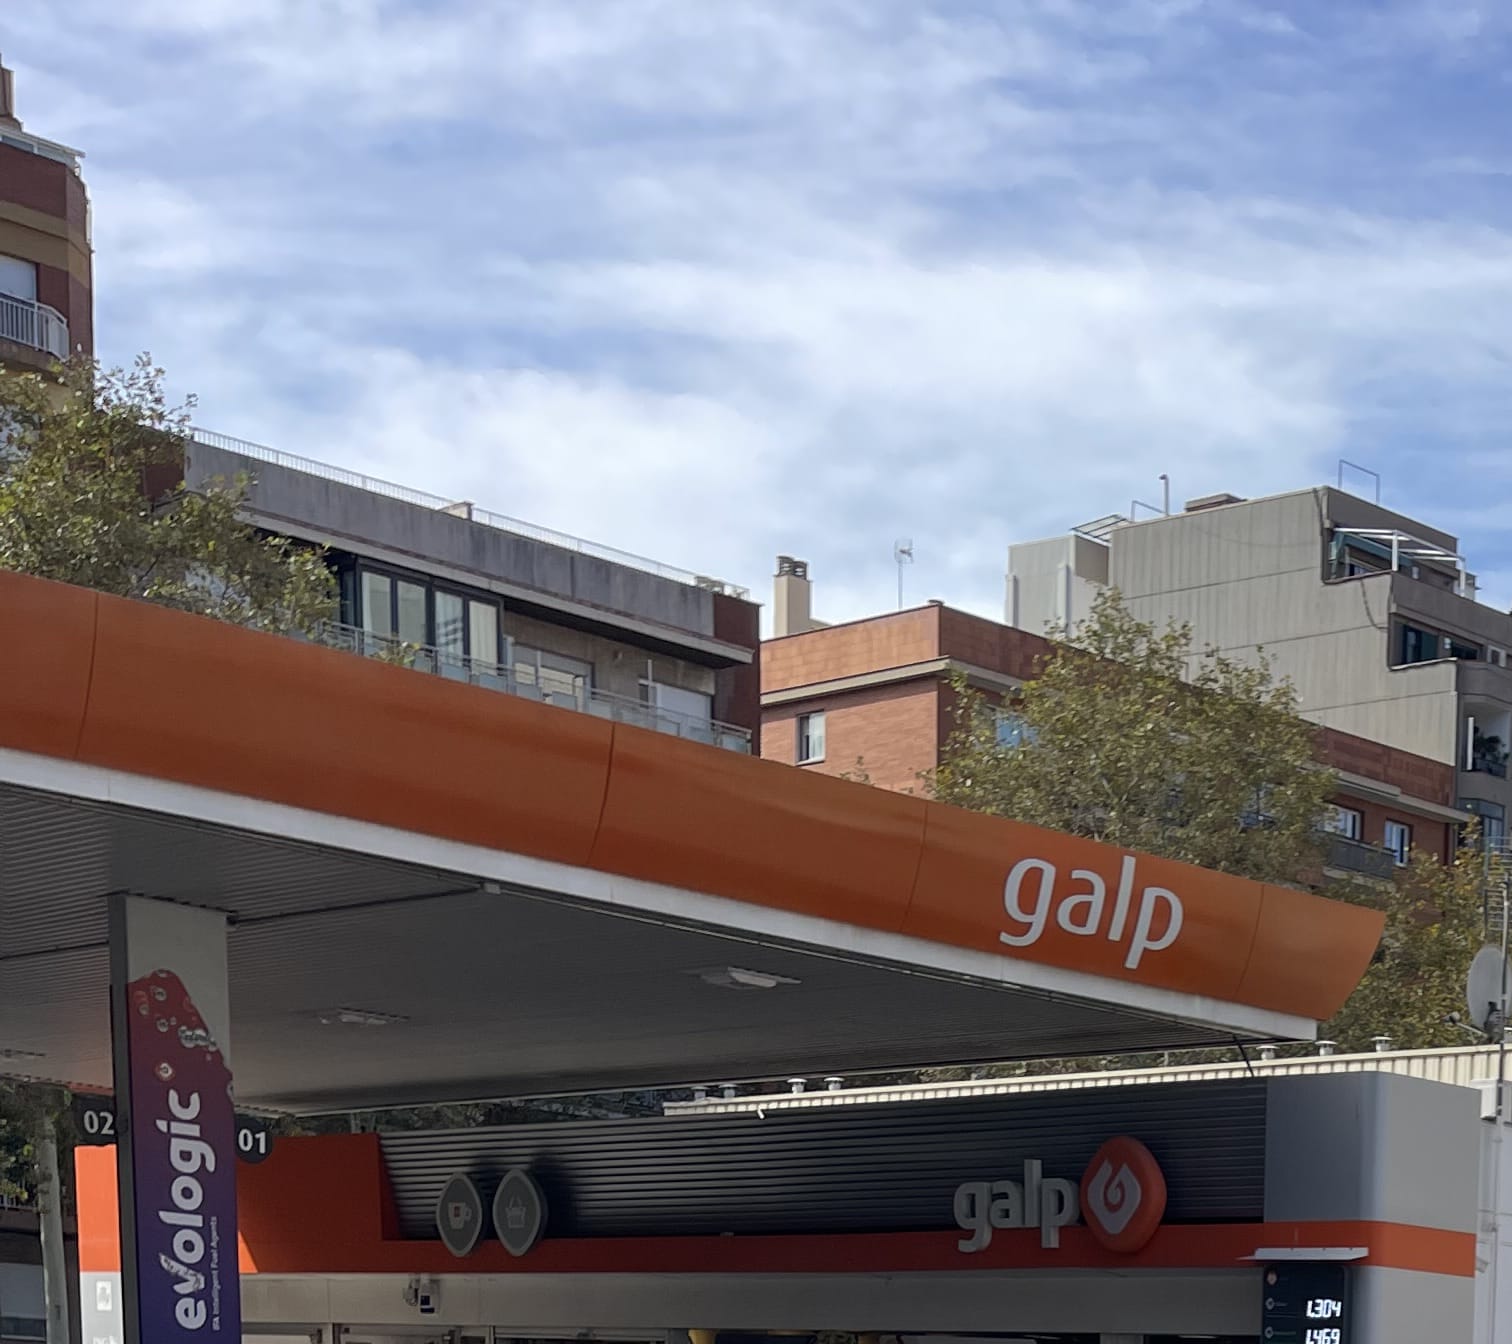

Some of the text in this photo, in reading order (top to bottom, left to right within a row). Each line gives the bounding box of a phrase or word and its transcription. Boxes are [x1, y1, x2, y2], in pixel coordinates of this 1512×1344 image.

[1000, 855, 1184, 970] galp
[83, 1110, 115, 1135] 02
[238, 1128, 266, 1154] 01
[156, 1089, 217, 1330] evologic
[953, 1159, 1080, 1253] galp
